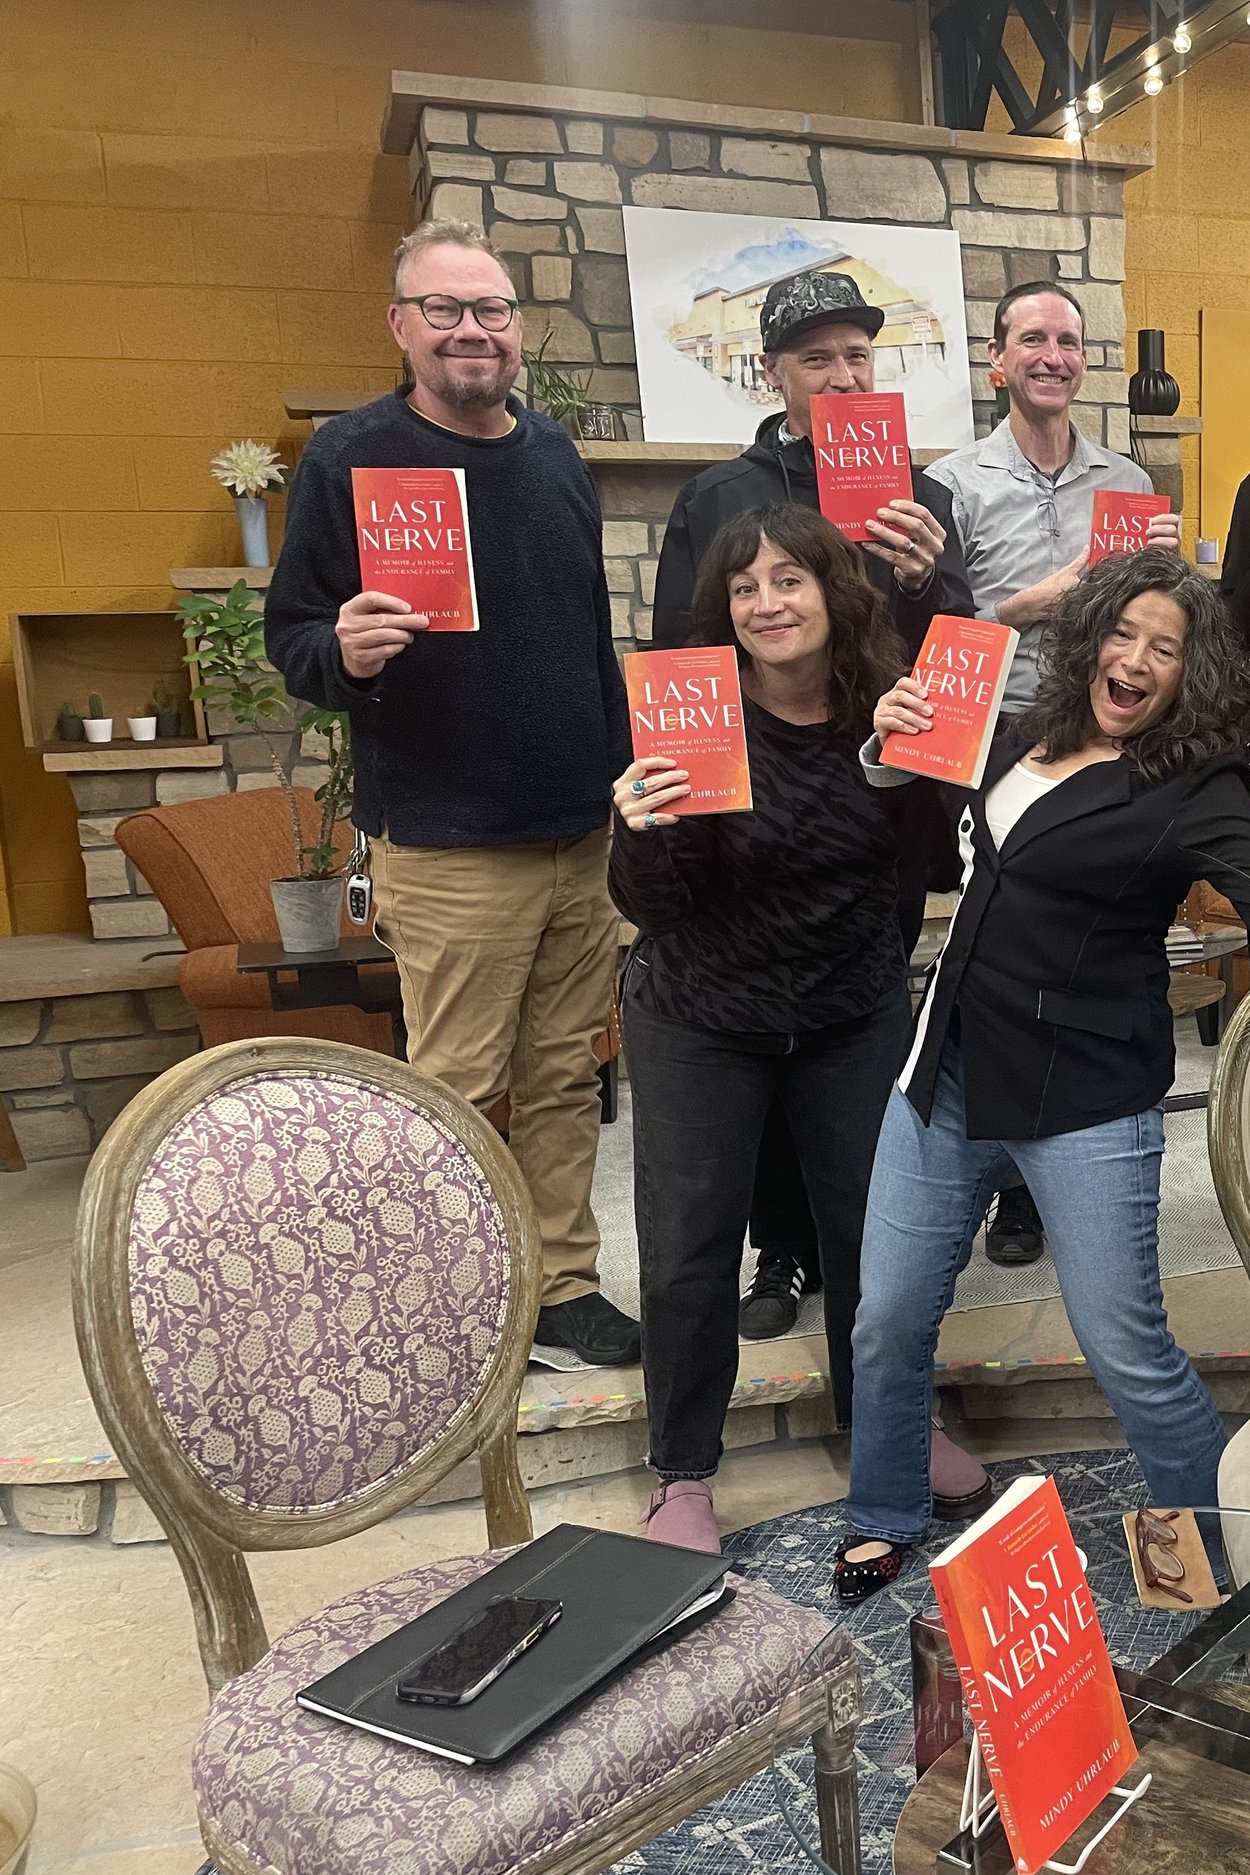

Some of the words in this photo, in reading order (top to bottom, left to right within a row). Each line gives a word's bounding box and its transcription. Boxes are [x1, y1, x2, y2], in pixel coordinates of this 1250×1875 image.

[827, 421, 891, 442] LAST
[818, 446, 906, 468] NERVE
[372, 500, 445, 522] LAST
[361, 528, 462, 550] NERVE
[926, 644, 989, 674] LAST
[645, 678, 721, 704] LAST
[914, 668, 992, 704] NERVE
[635, 705, 739, 733] NERVE
[690, 788, 737, 799] UHRLAUB
[982, 1544, 1059, 1648] LAST
[983, 1584, 1093, 1713] NERVE
[1020, 1690, 1052, 1723] MEMOIR
[1057, 1656, 1085, 1687] ILLNESS
[1024, 1693, 1069, 1741] ENDURANCE
[1075, 1665, 1097, 1692] FAMILY
[960, 1666, 983, 1711] LAST
[976, 1719, 1002, 1778] NERVE
[1000, 1793, 1017, 1837] UHRLAUB
[1039, 1790, 1074, 1832] MINDY
[1076, 1738, 1121, 1793] UHRLAUB
